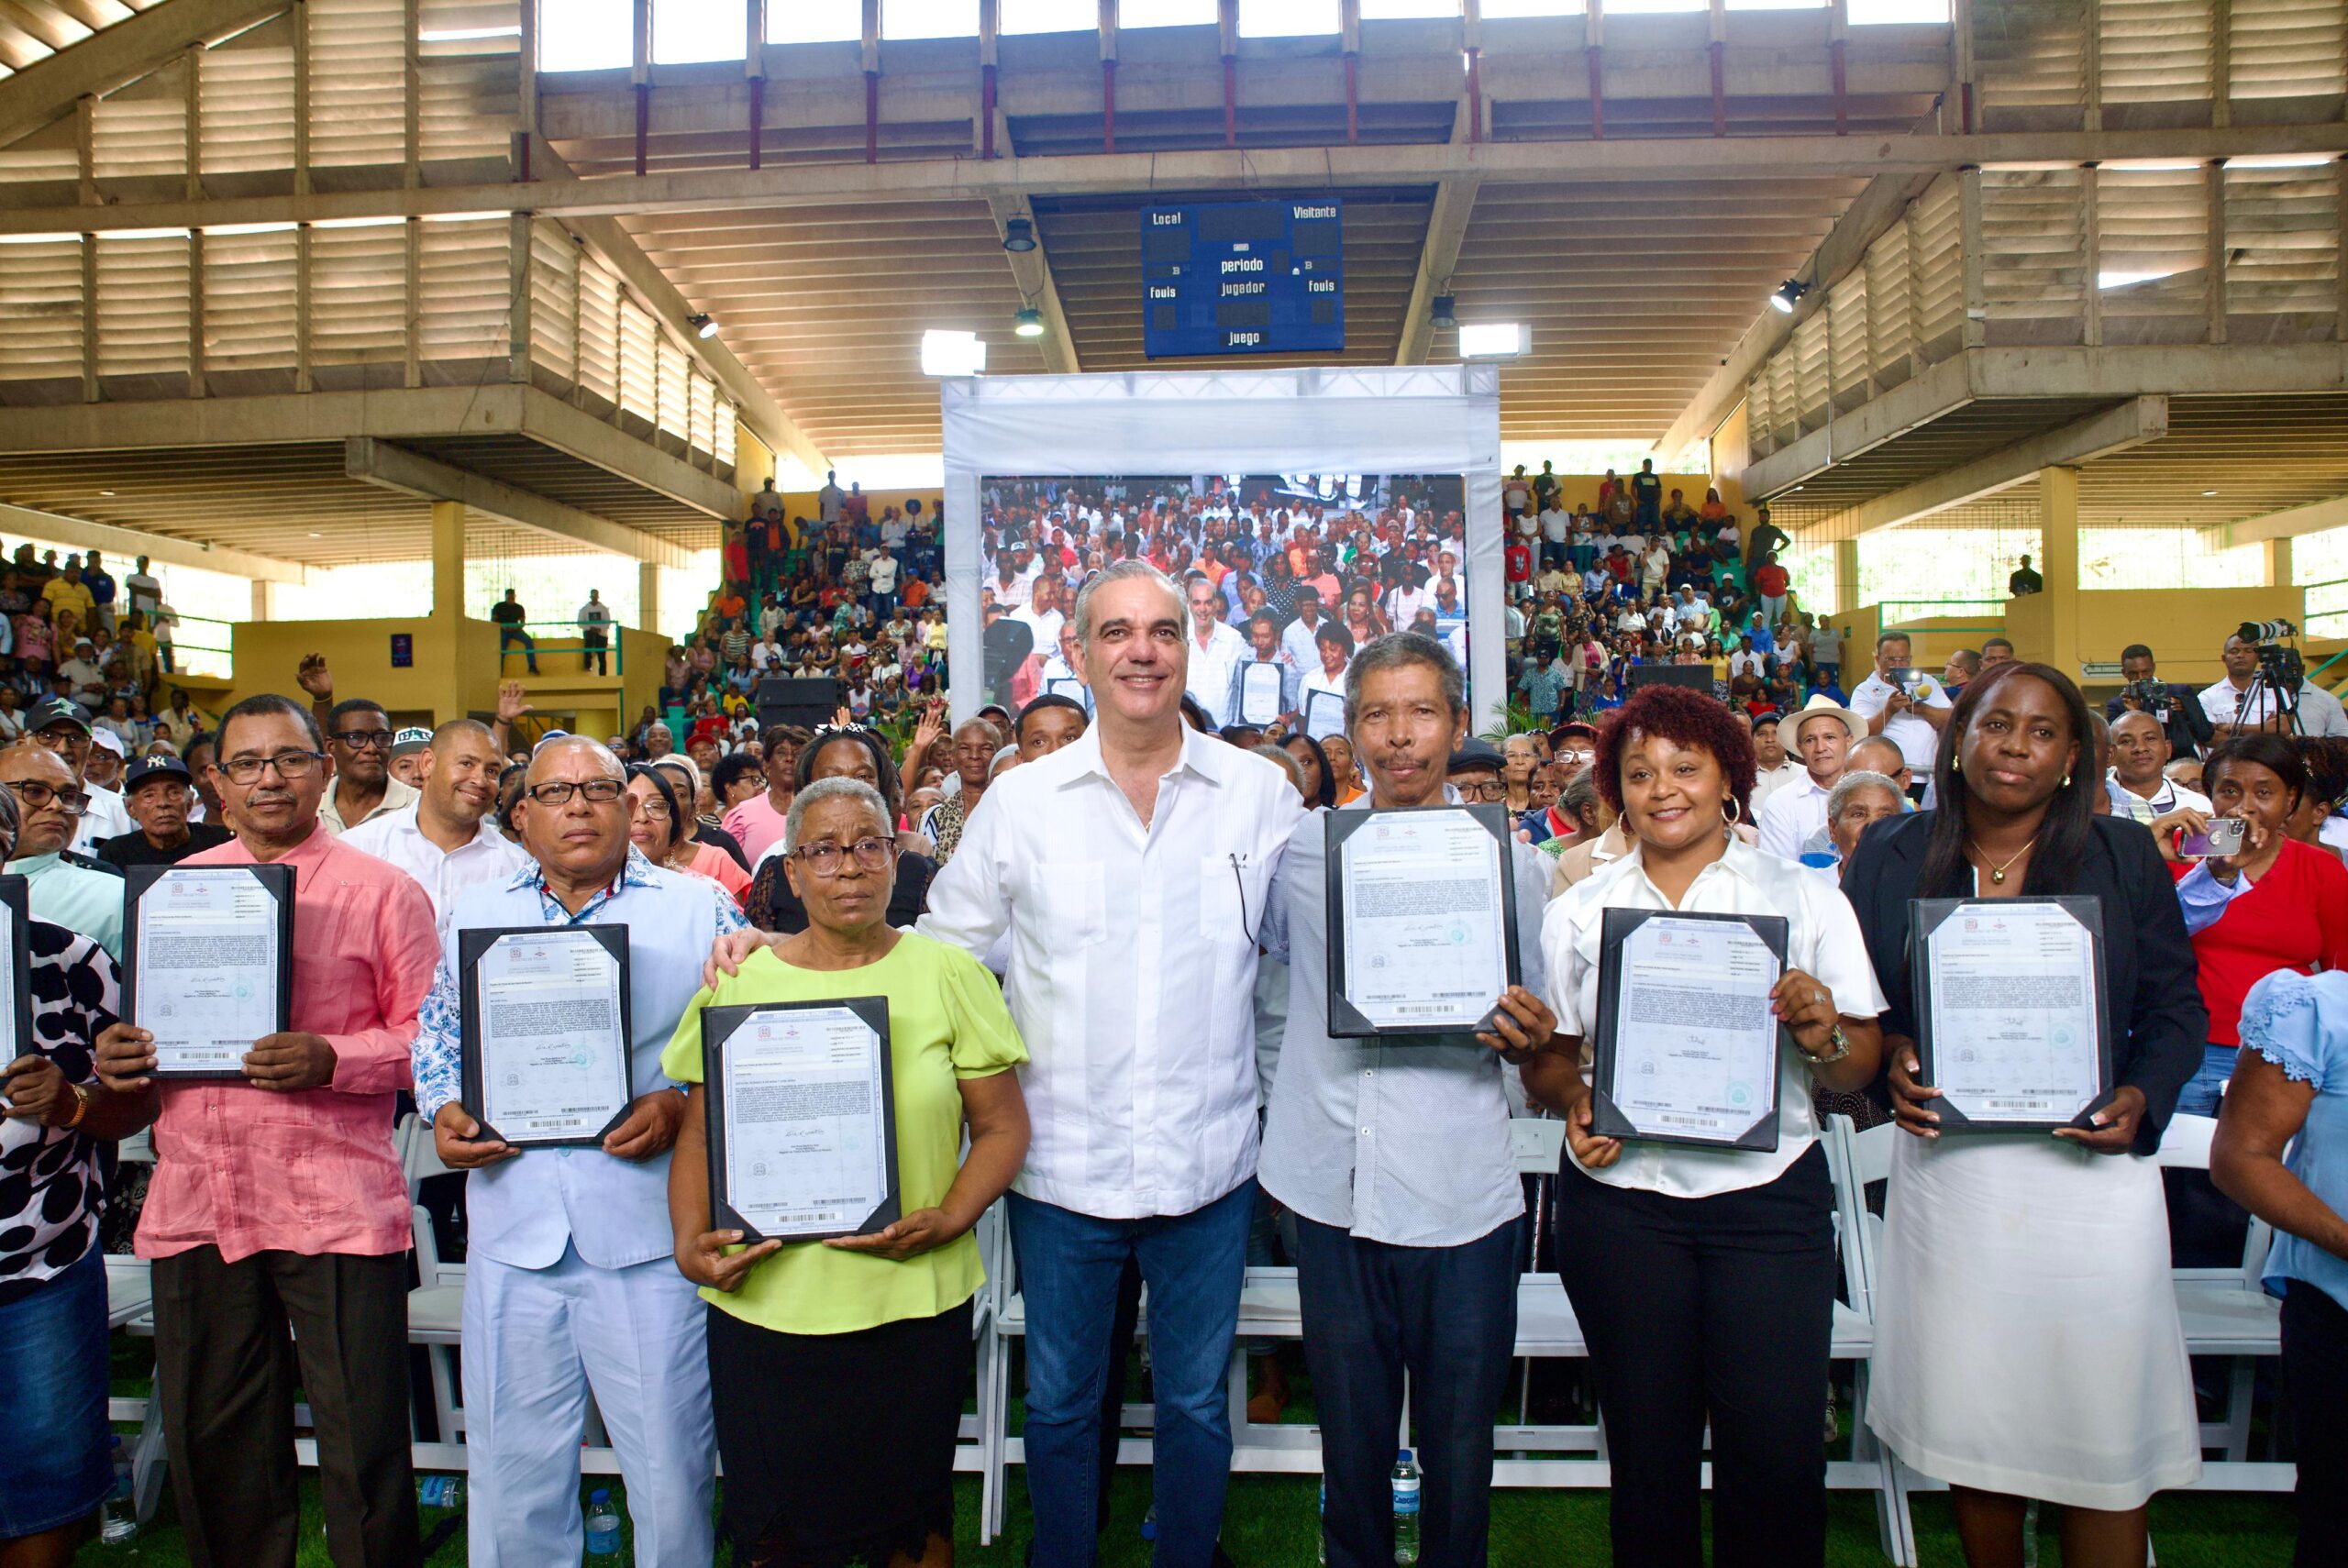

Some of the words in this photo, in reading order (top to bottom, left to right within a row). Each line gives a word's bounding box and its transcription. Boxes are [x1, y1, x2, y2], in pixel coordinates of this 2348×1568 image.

[1153, 212, 1180, 226] Local
[1293, 206, 1336, 219] Visitante
[1221, 259, 1263, 274] periodo
[1150, 286, 1176, 299] fouls
[1221, 282, 1265, 296] jugador
[1308, 280, 1335, 293] fouls
[1228, 332, 1260, 346] juego
